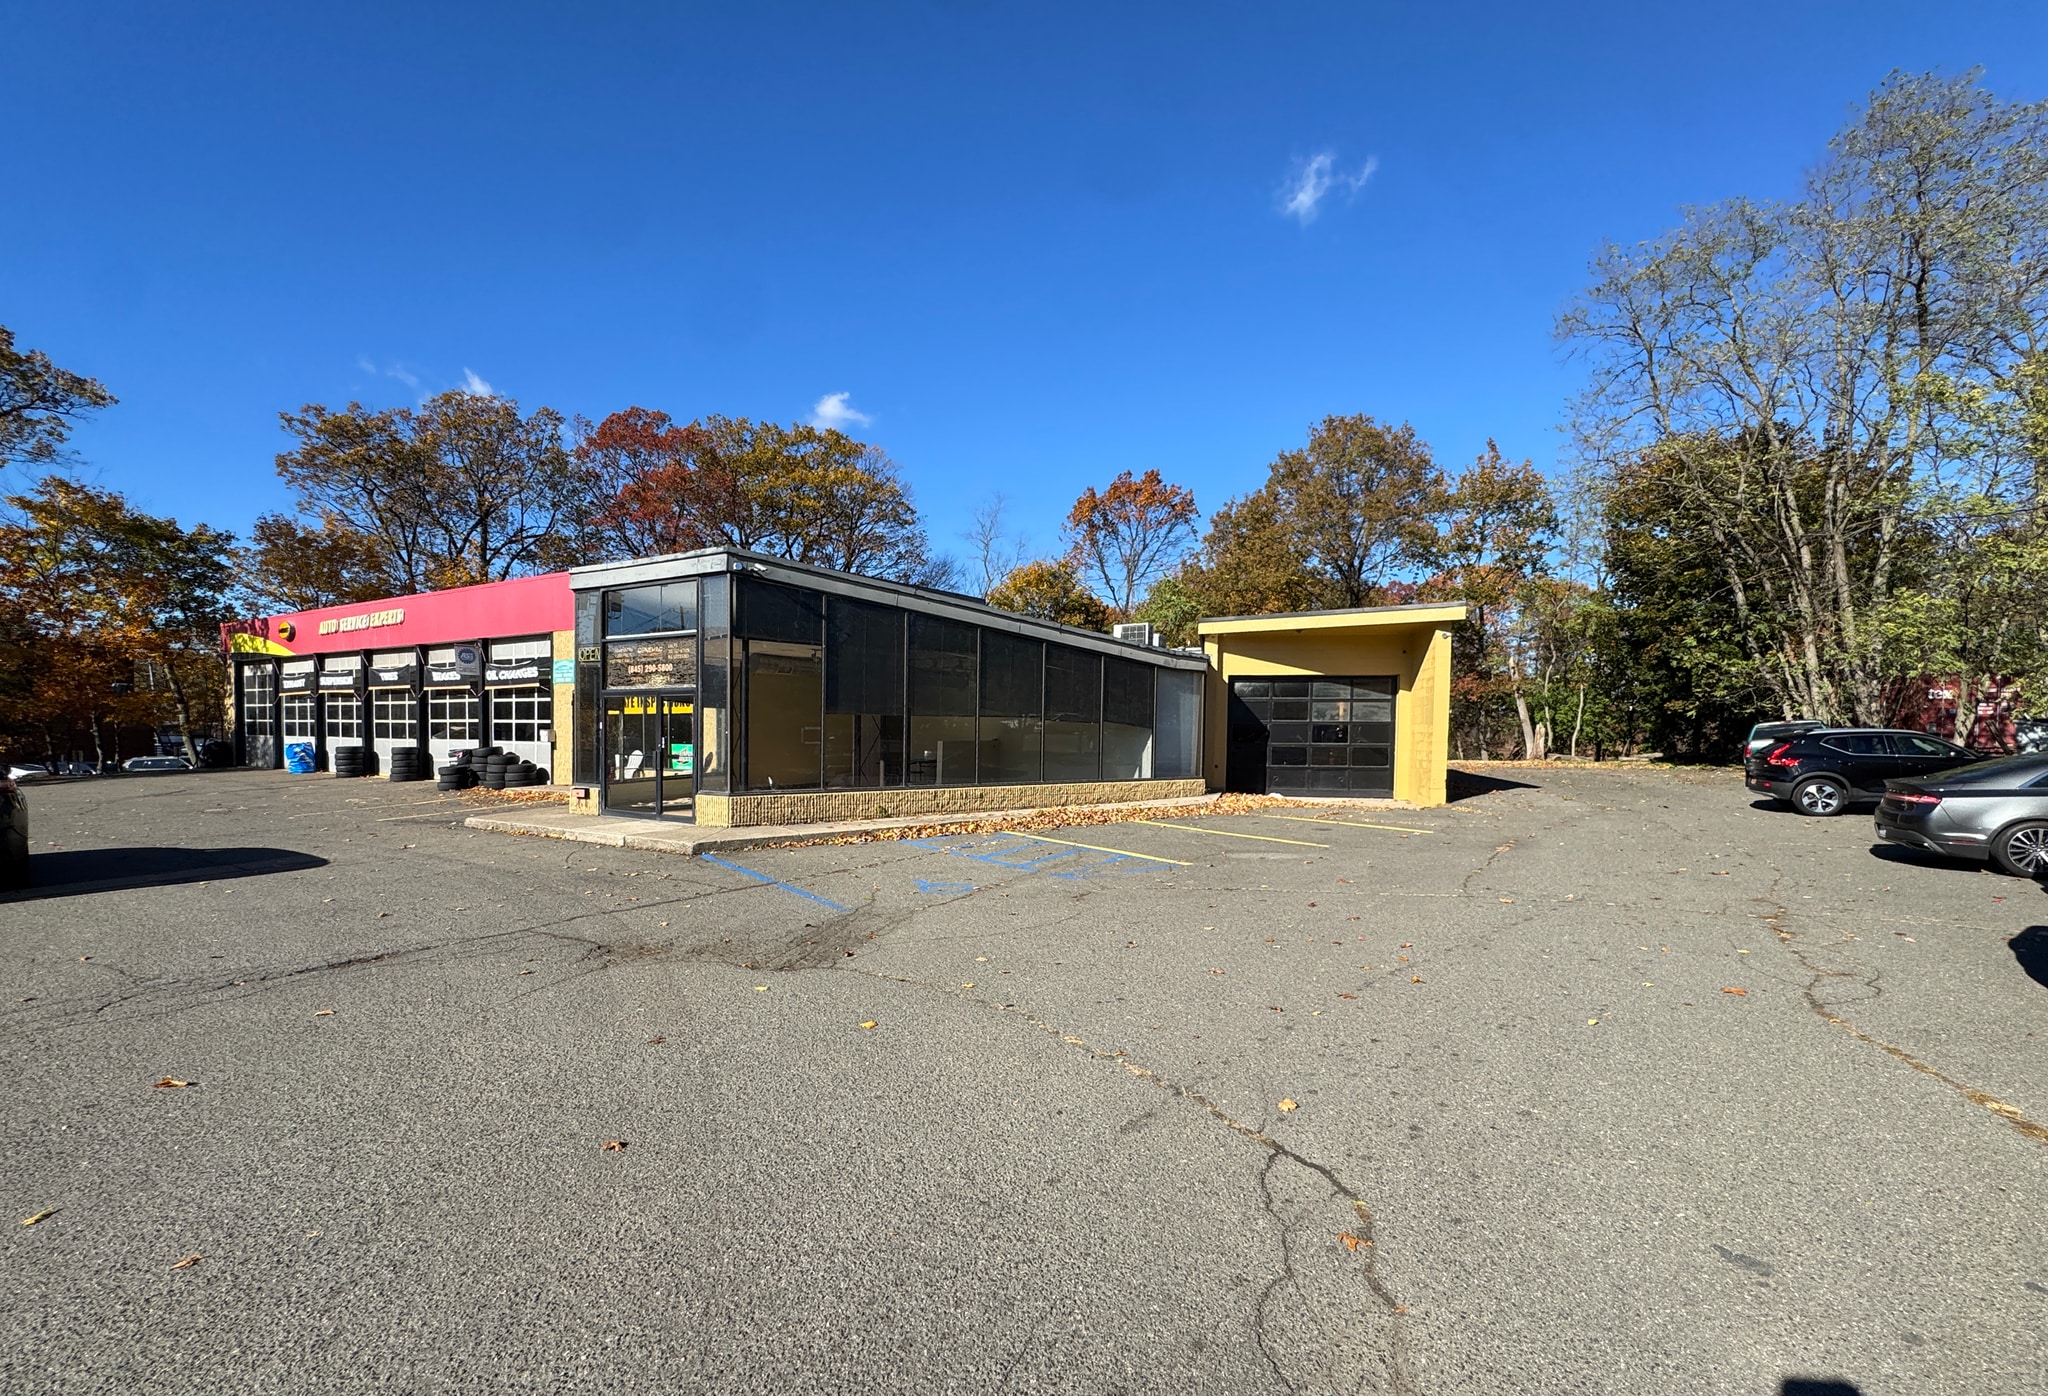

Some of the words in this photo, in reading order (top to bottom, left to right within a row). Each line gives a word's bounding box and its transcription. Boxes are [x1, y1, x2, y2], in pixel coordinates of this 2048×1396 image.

[580, 648, 599, 660] OPEN
[486, 669, 498, 680] OIL
[499, 666, 539, 680] CHANGES
